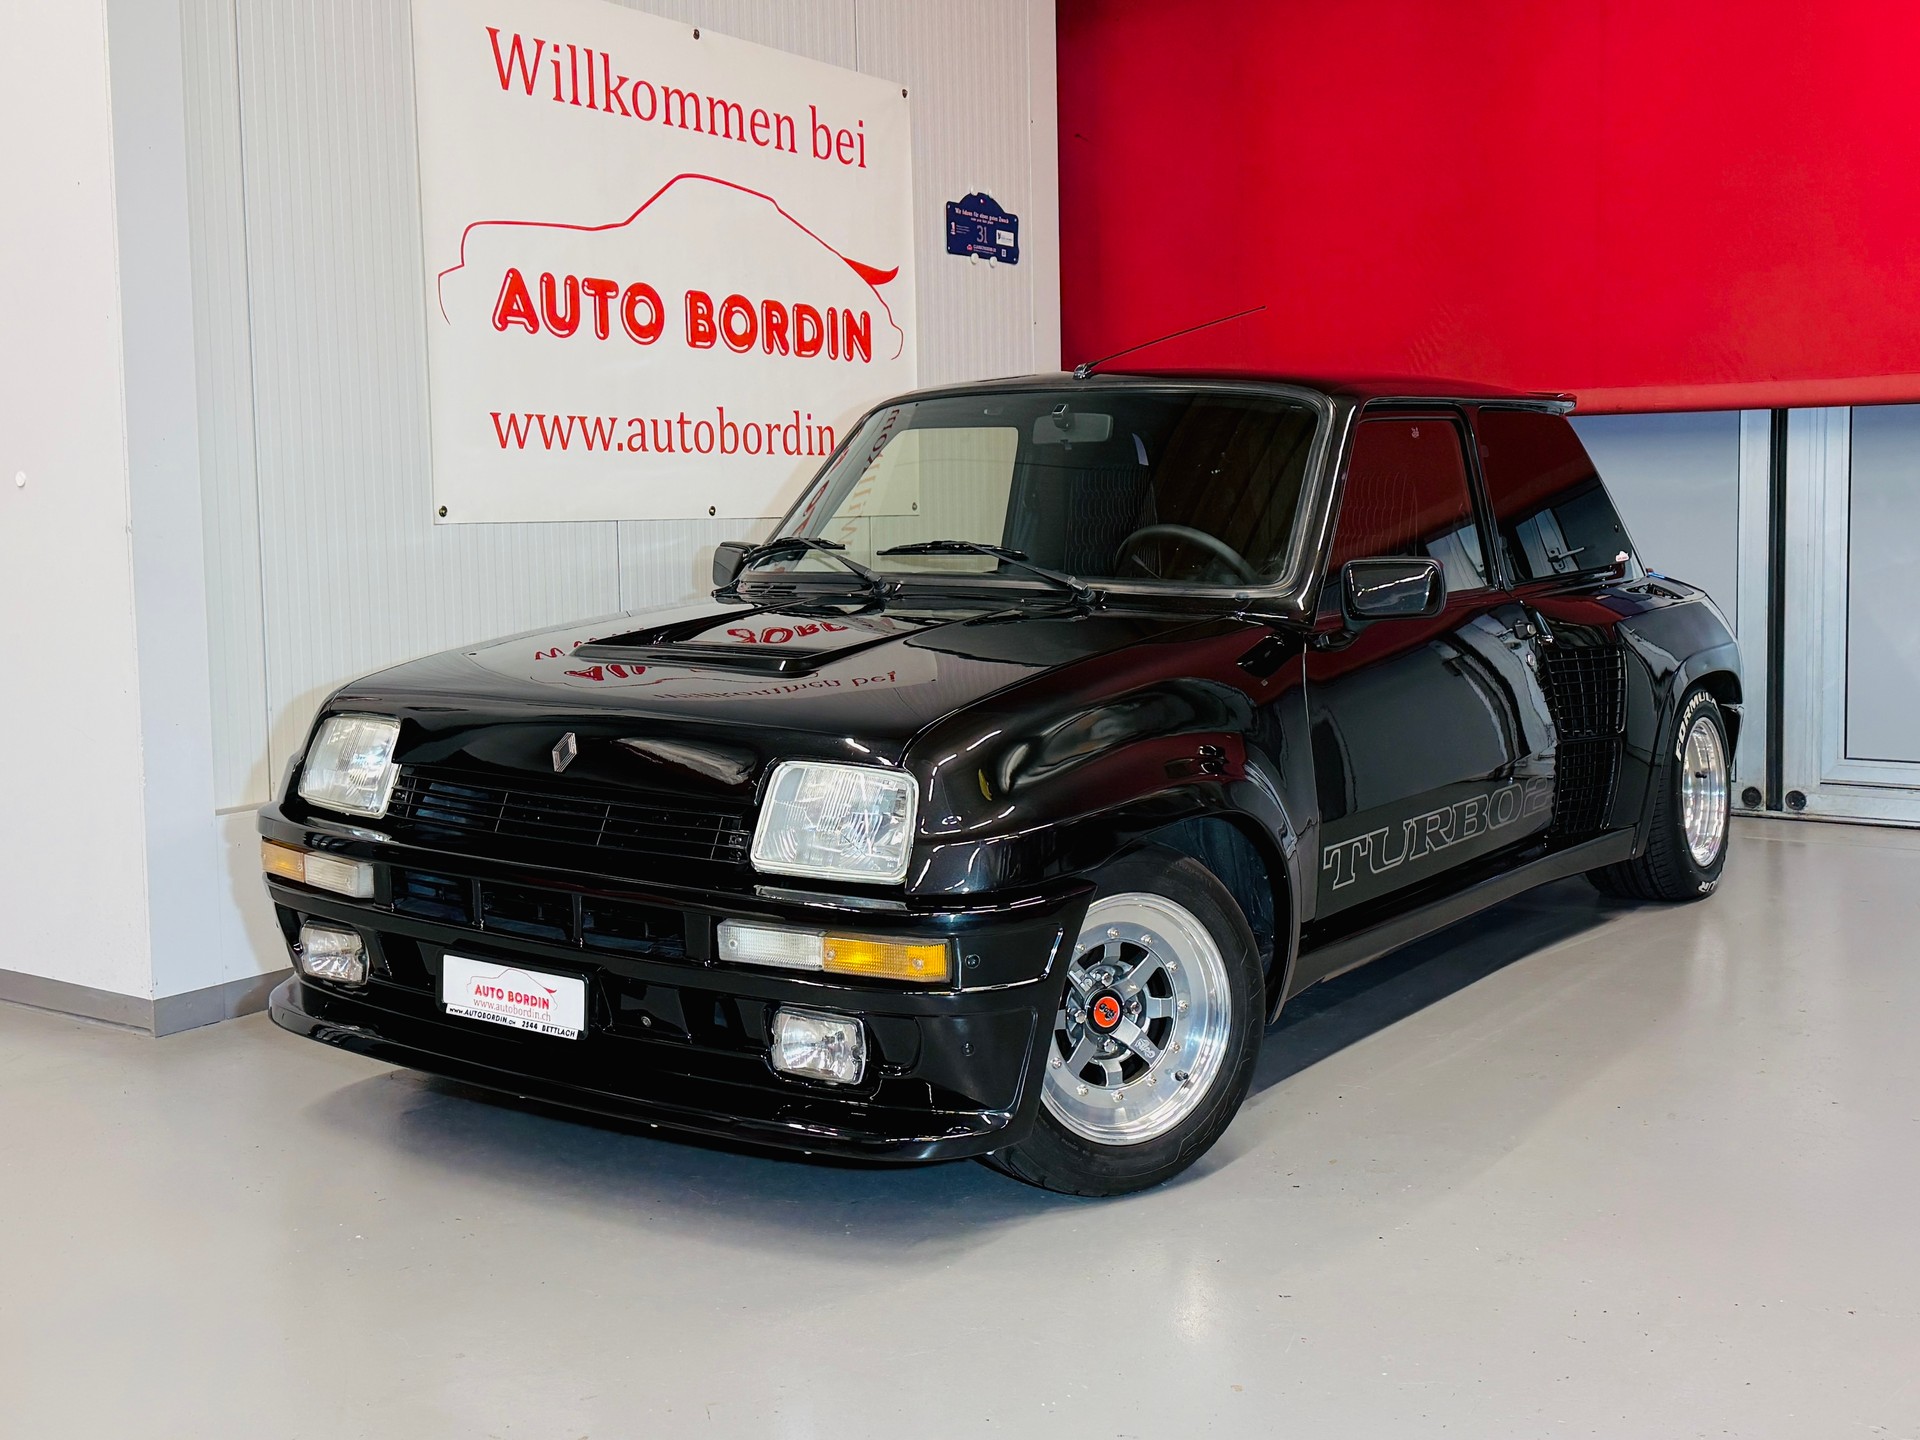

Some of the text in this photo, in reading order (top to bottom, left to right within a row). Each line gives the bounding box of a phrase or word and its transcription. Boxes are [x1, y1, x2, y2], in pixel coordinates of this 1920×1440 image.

[485, 26, 867, 169] Willkommen bei
[976, 225, 988, 244] 31
[491, 267, 872, 364] AUTO BORDIN
[475, 984, 550, 1010] AUTO BORDIN
[473, 999, 551, 1021] www.autobordin.ch
[521, 1020, 539, 1030] 2544
[541, 1024, 575, 1037] BETTLACH
